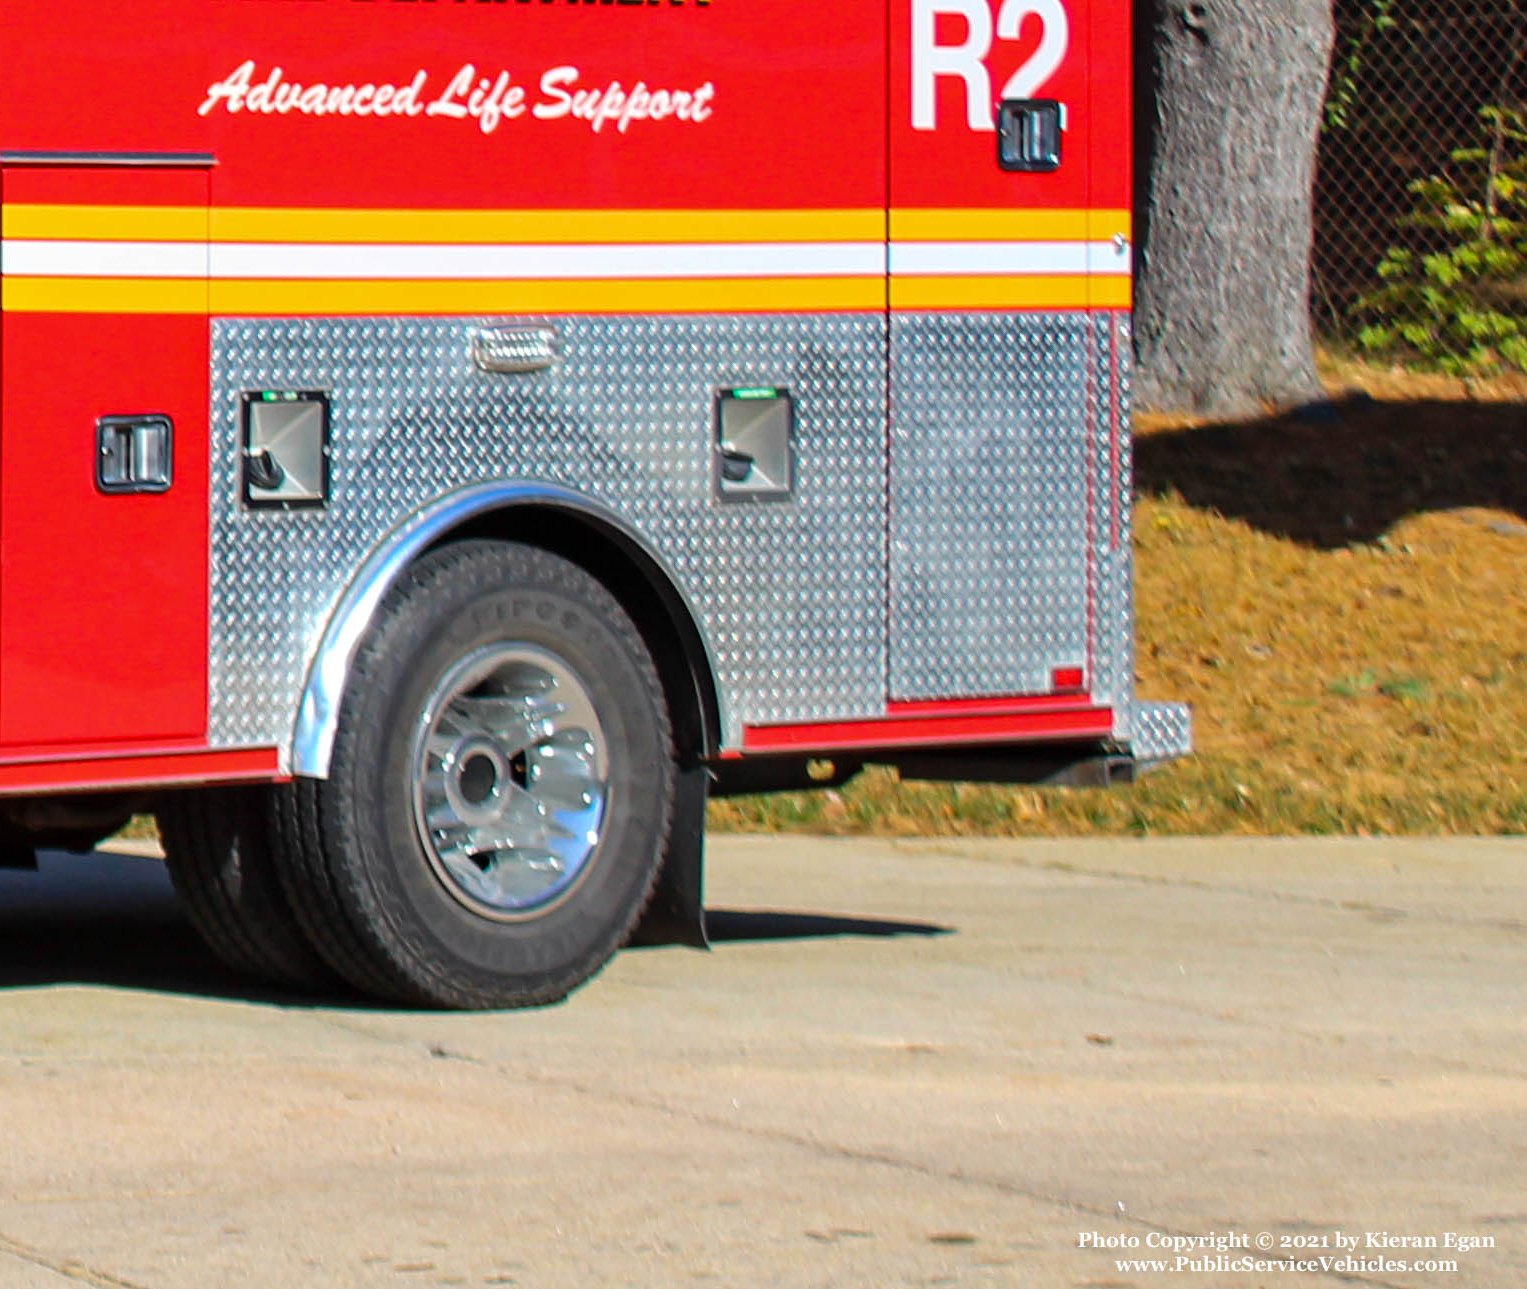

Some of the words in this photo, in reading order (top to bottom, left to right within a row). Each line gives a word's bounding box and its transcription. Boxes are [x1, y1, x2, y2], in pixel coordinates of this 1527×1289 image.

[198, 60, 424, 117] Advanced
[426, 64, 526, 134] Life
[532, 65, 716, 134] Support
